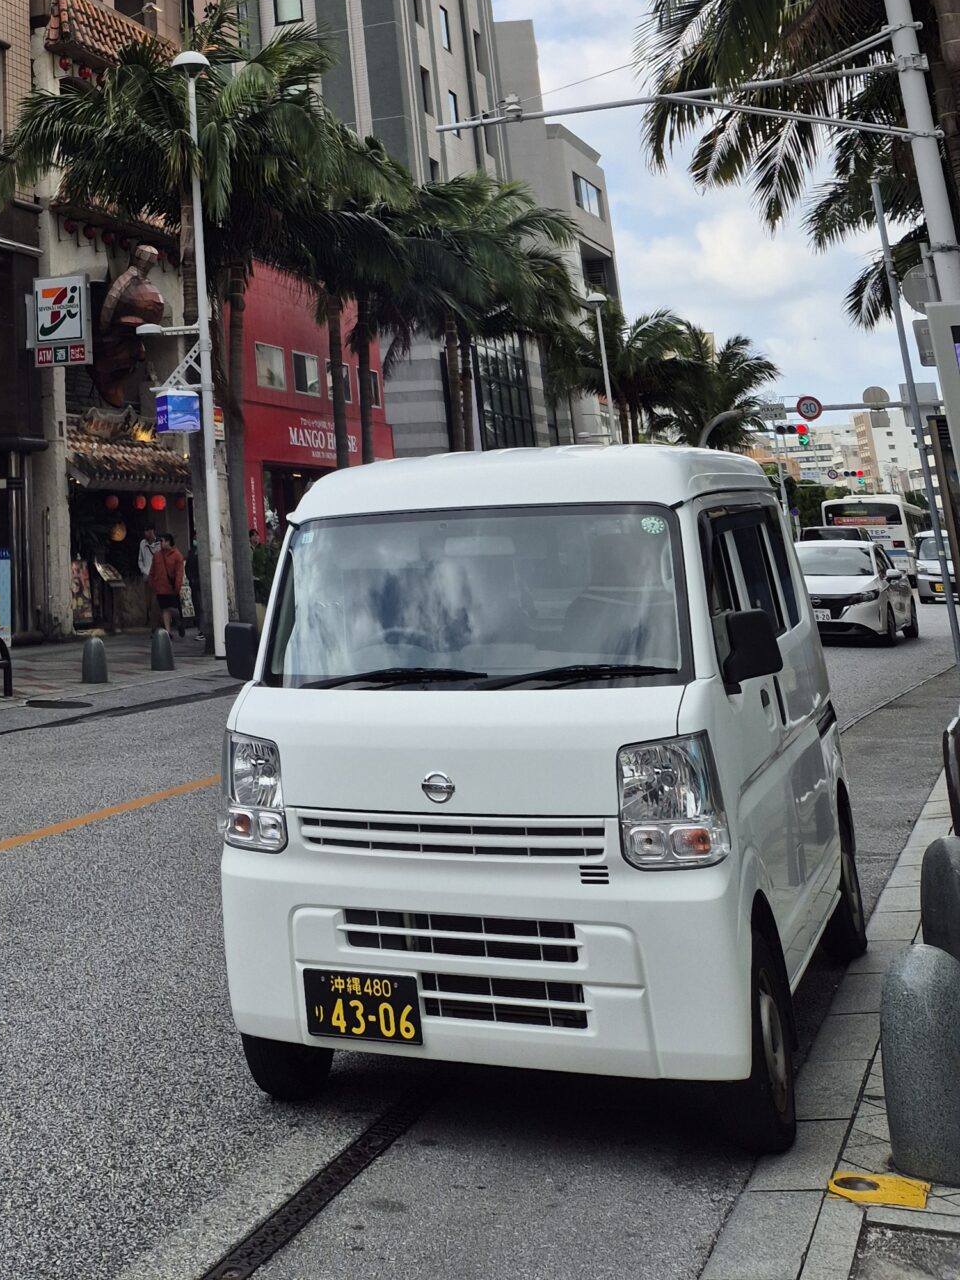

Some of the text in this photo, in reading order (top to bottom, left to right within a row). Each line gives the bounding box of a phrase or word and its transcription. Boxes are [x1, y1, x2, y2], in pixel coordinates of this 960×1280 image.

[39, 350, 52, 363] ATM
[802, 402, 817, 414] 30
[288, 426, 358, 453] MANGO HSE
[331, 998, 416, 1040] 43-06
